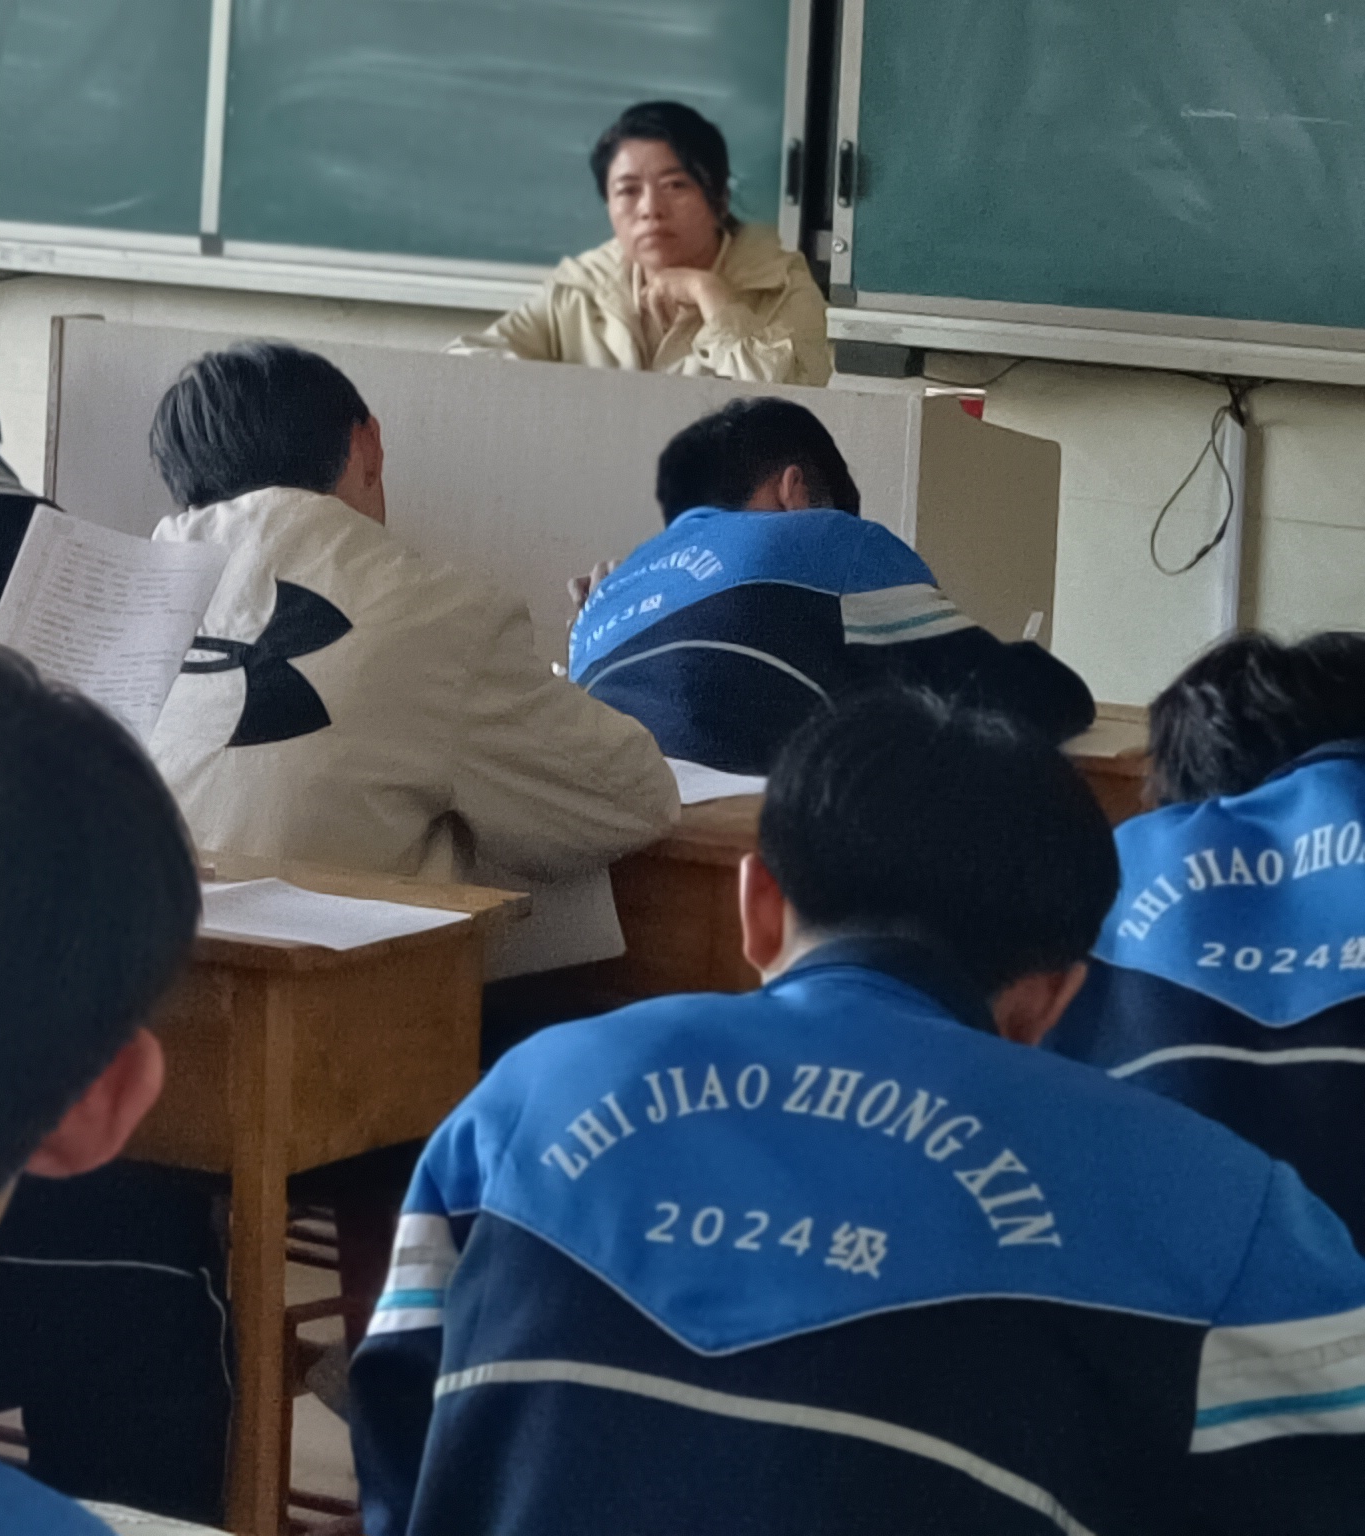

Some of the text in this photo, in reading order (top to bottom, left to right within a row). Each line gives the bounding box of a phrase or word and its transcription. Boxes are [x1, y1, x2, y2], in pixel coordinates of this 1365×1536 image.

[1117, 820, 1365, 941] ZHI JIAO ZHO
[540, 1063, 1063, 1249] ZHI JIAO ZHONG XIN
[644, 1202, 889, 1279] 2024级
